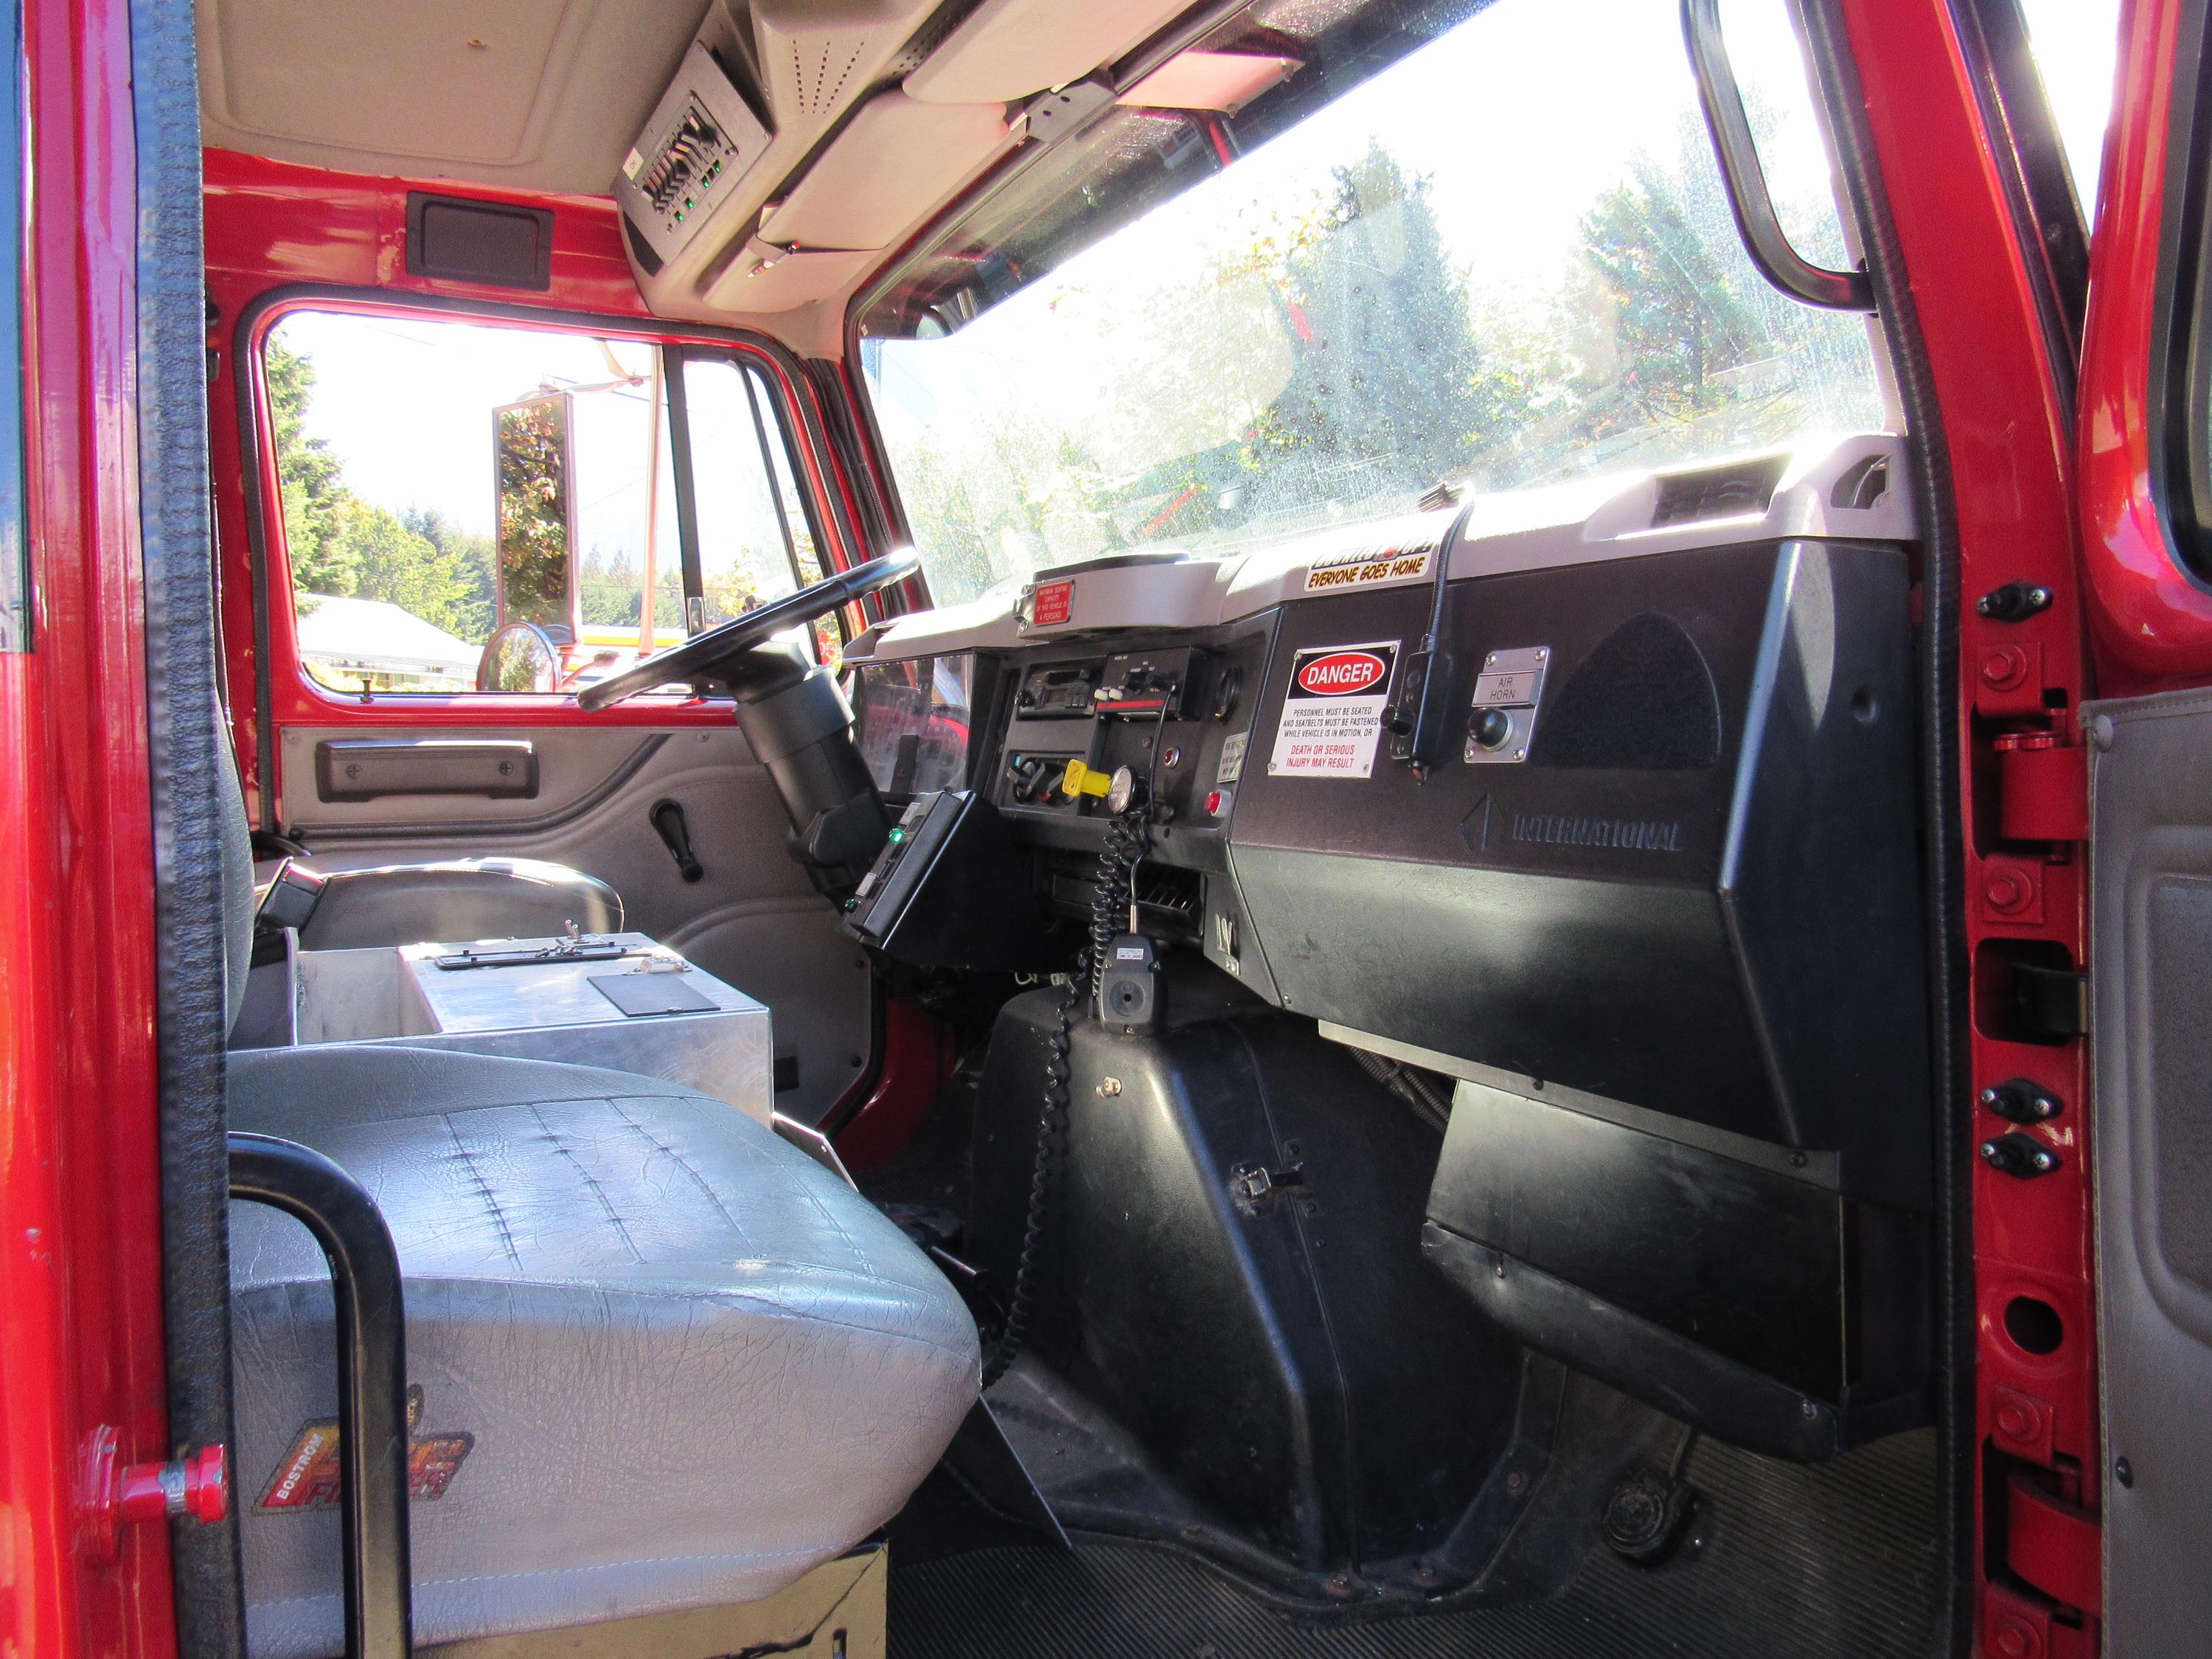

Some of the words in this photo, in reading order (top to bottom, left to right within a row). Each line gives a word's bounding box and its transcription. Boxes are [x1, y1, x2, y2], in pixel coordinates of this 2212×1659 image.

[1308, 566, 1360, 588] EVERYONE
[1360, 563, 1390, 581] GOES
[1389, 556, 1425, 577] HOME
[1307, 663, 1374, 685] DANGER
[1498, 677, 1513, 687] AIR
[1490, 689, 1516, 700] HORN
[1293, 709, 1324, 717] PERSONNEL
[1325, 707, 1342, 716] MUST
[1342, 707, 1350, 715] BE
[1350, 706, 1372, 715] SEATED
[1294, 719, 1324, 727] SEATBELTS
[1324, 718, 1340, 726] MUST
[1349, 717, 1379, 726] FASTENED
[1284, 729, 1301, 737] WHILE
[1302, 729, 1324, 737] VEHICLE
[1338, 728, 1362, 737] MOTION,
[1363, 728, 1372, 737] OR
[1291, 745, 1312, 754] DEATH
[1313, 745, 1324, 754] OR
[1324, 745, 1355, 755] SERIOUS
[1286, 758, 1310, 768] INJURY
[1311, 758, 1328, 768] MAY
[1328, 758, 1354, 768] RESULT
[1512, 814, 1683, 851] INTERNATIONAL
